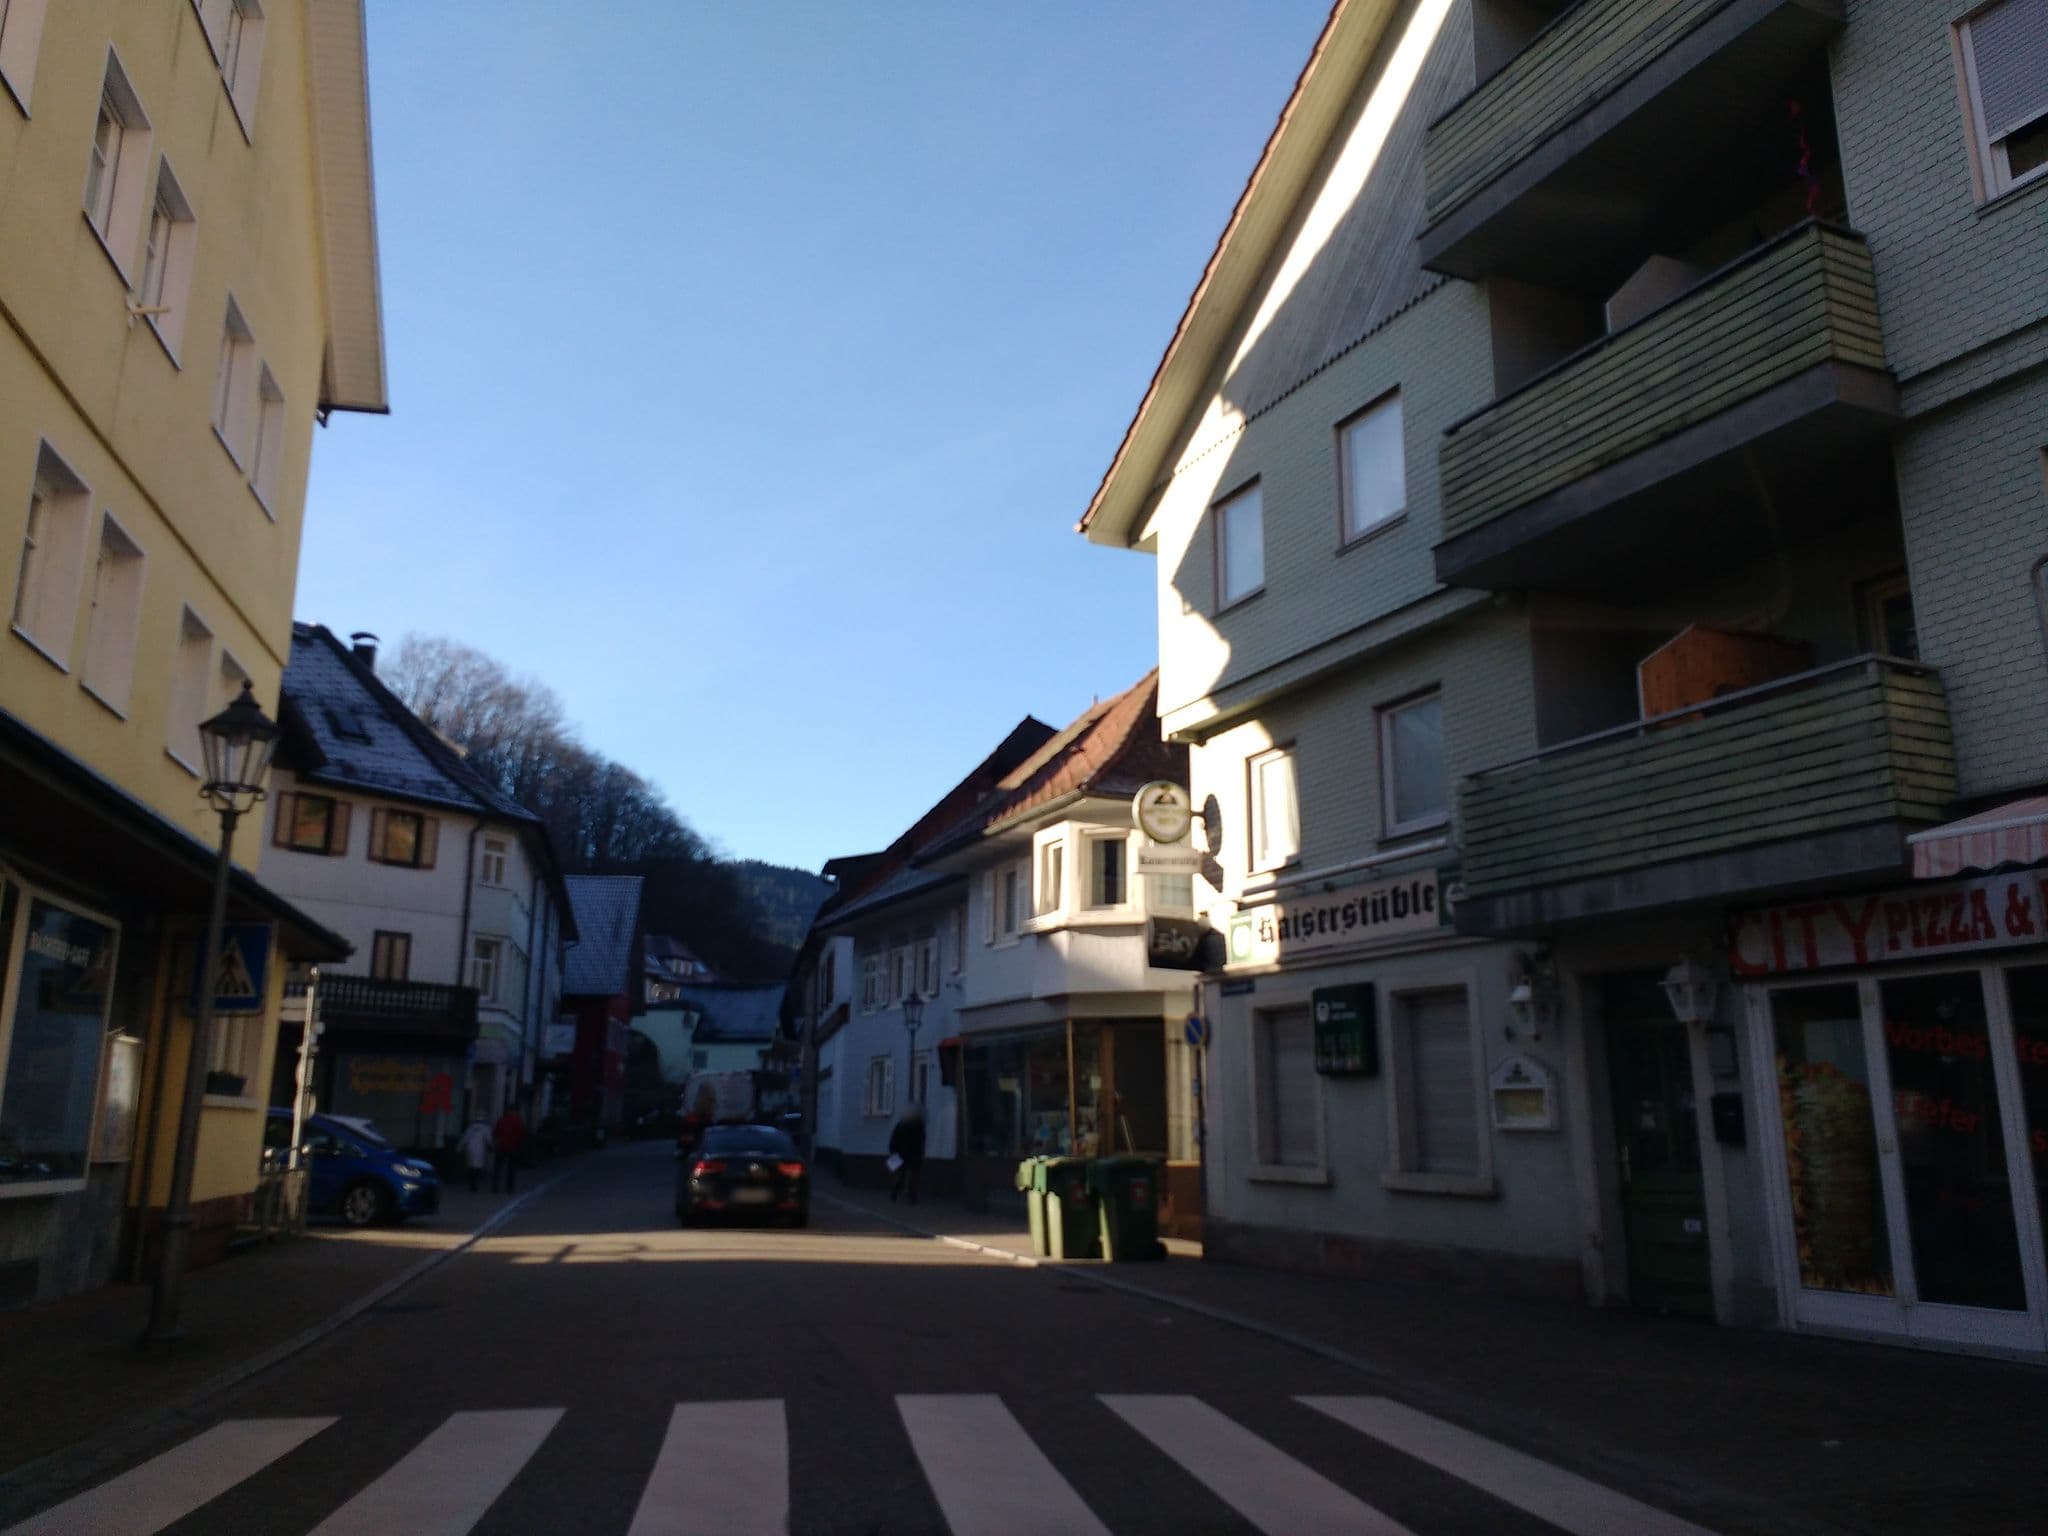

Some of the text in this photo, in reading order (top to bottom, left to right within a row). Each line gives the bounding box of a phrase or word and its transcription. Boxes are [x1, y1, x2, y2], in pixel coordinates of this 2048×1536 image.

[1728, 896, 1880, 977] CITY
[1886, 889, 1995, 950] PIZZA
[2006, 883, 2034, 936] &
